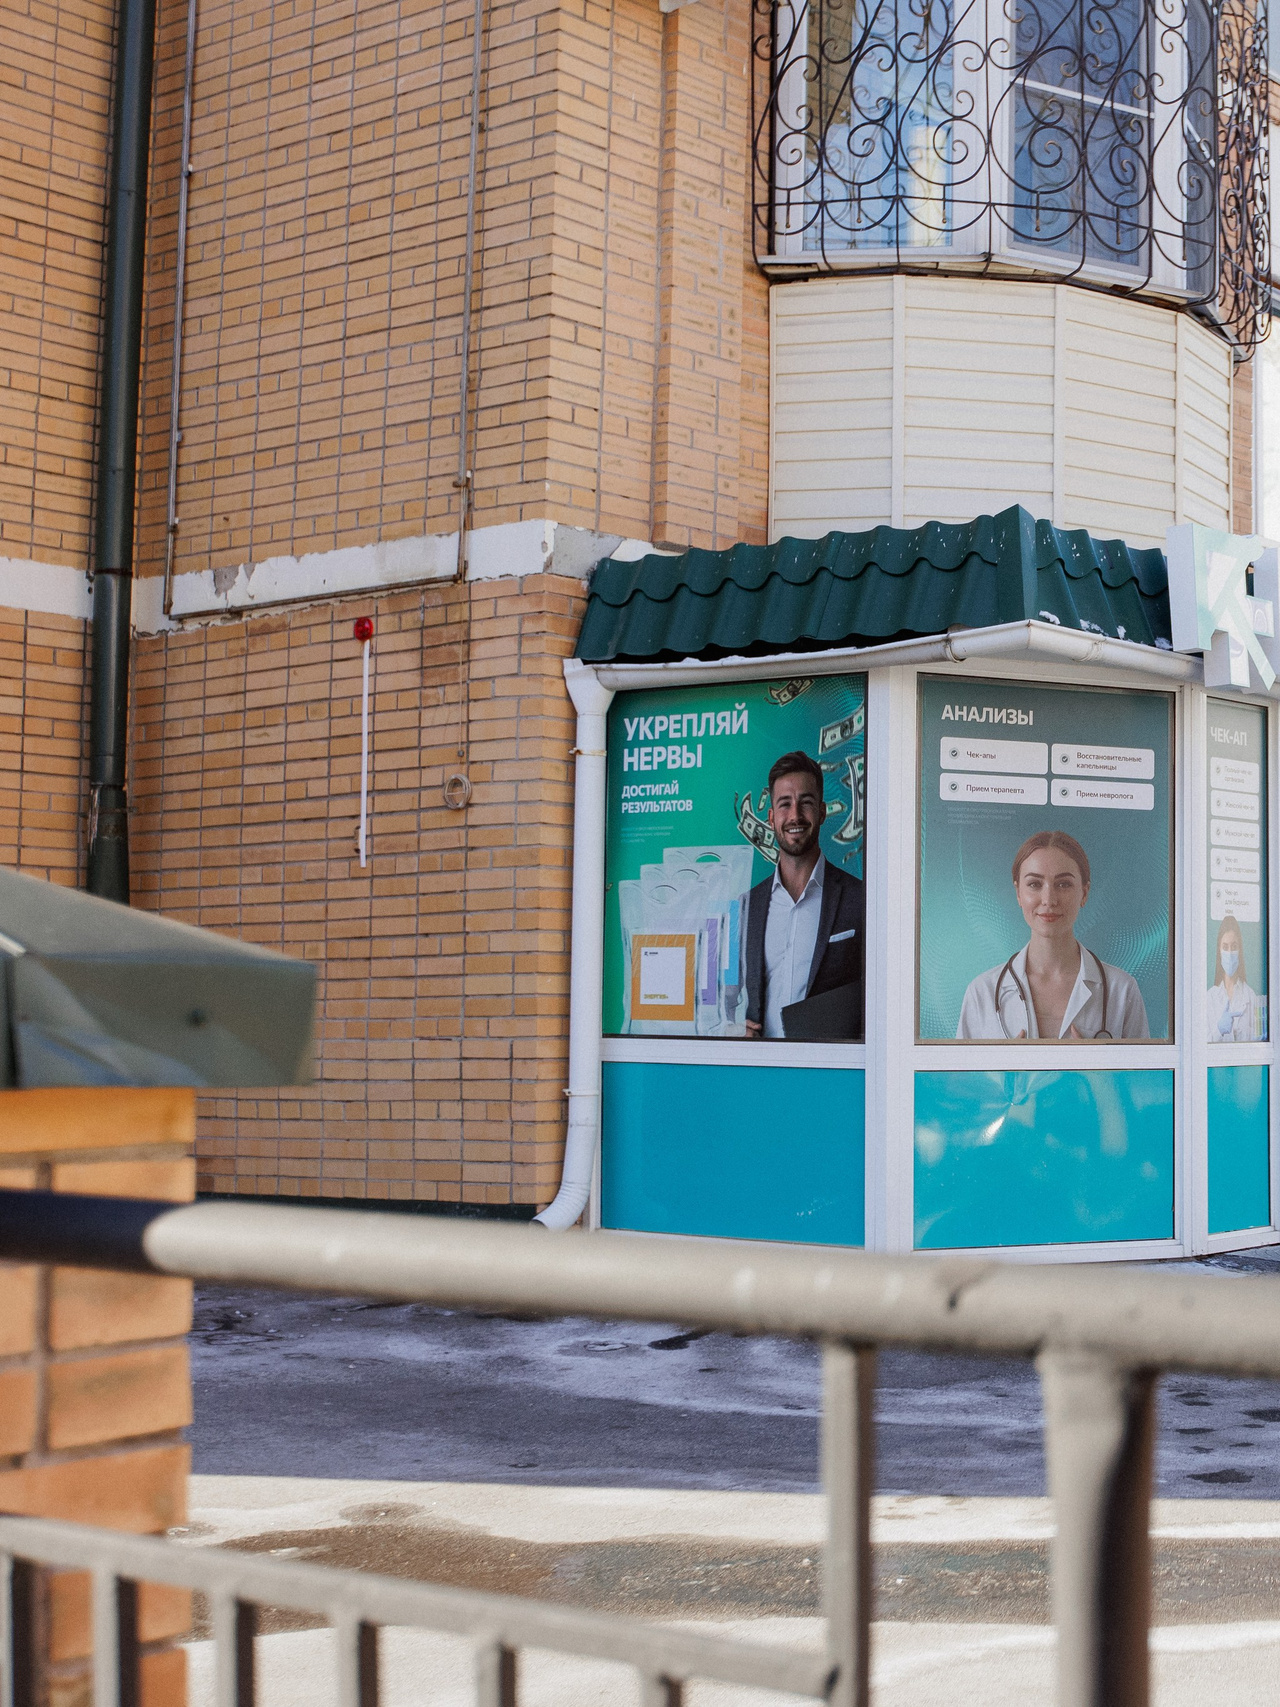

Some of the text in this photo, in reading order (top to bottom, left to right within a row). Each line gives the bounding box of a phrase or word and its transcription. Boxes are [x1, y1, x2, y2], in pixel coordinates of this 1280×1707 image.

[623, 702, 749, 742] УКРЕПЛЯЙ
[941, 704, 1034, 726] АНАЛИЗЫ
[1210, 726, 1247, 746] ЧЕК-АП
[623, 744, 703, 772] НЕРВЫ
[966, 750, 997, 760] Чек-апы
[1076, 751, 1143, 763] Восстановительные
[1076, 763, 1118, 771] капельницы
[621, 780, 680, 799] ДОСТИГАЙ
[965, 784, 1025, 795] Прием терапевта
[1076, 789, 1134, 800] Прием невролога
[621, 799, 694, 815] РЕЗУЛЬТАТОВ
